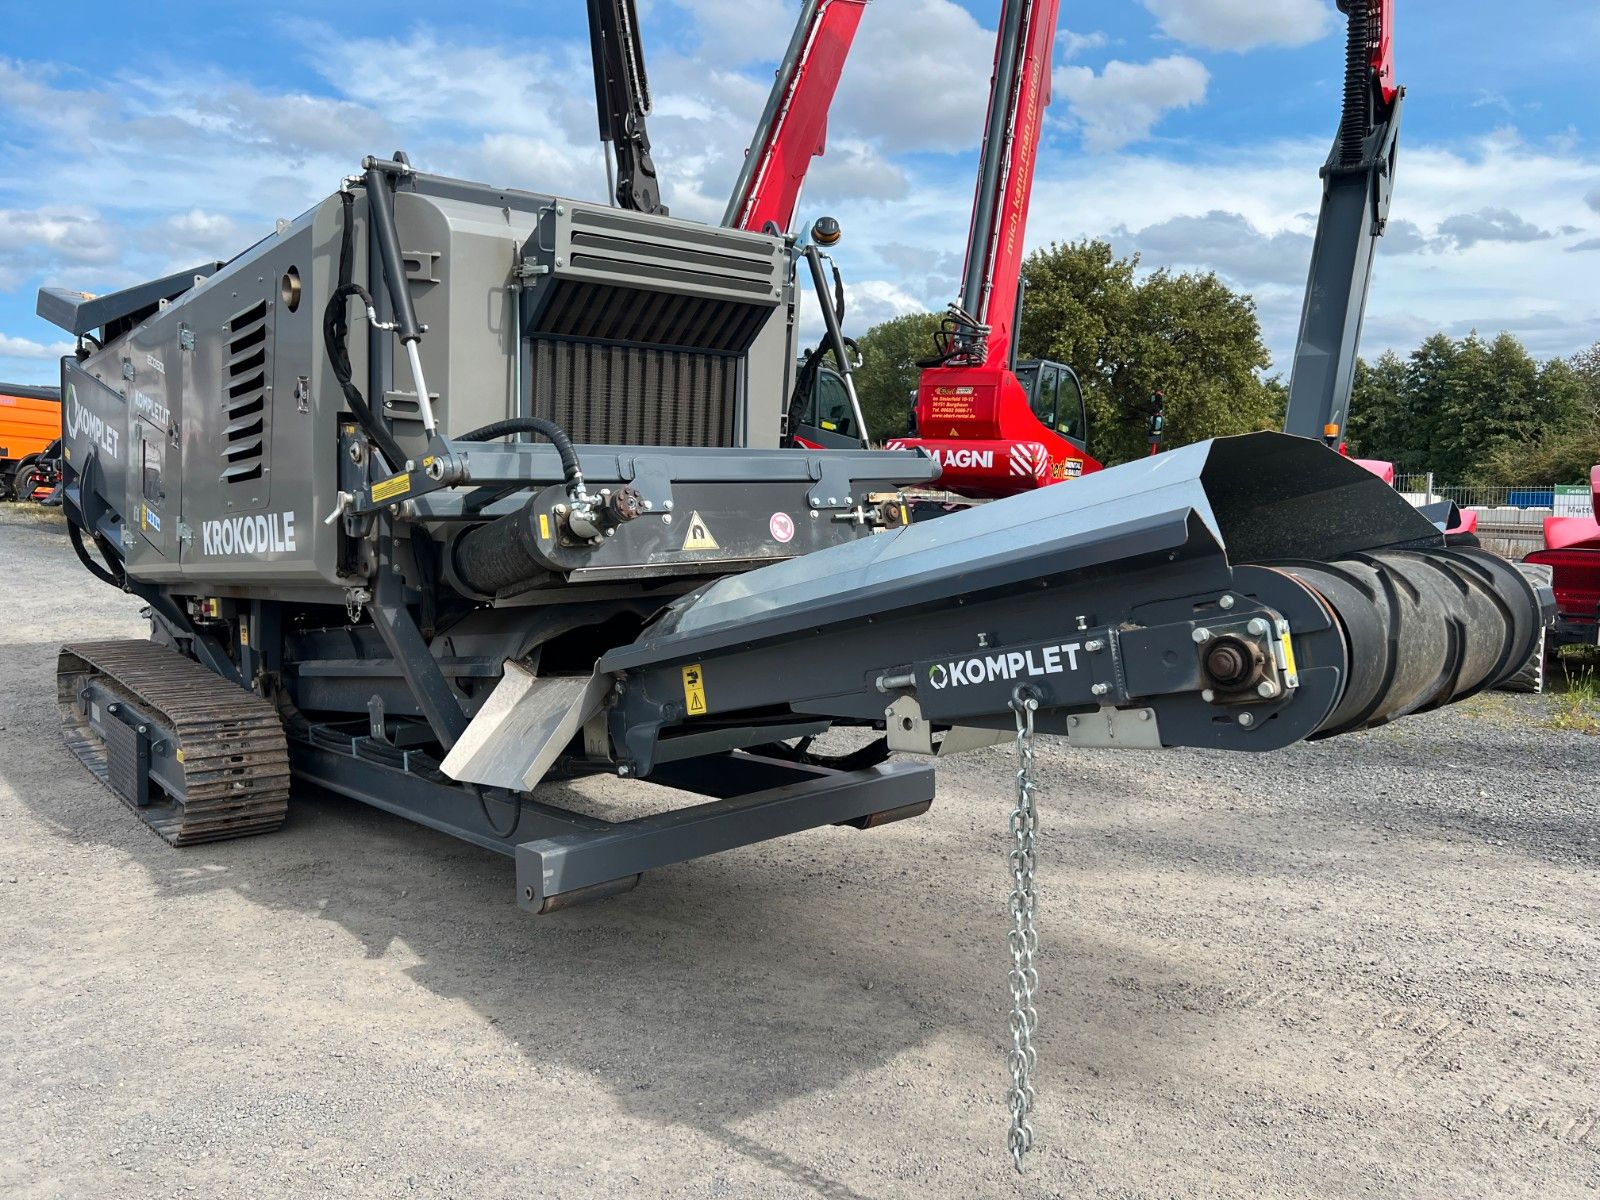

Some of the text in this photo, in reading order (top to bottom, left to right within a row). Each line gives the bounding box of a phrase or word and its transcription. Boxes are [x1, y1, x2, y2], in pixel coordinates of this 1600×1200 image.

[1006, 55, 1041, 256] mich kann man mieten!
[134, 388, 171, 427] KOMPLET.IT
[76, 403, 119, 459] KOMPLET
[202, 511, 296, 556] KROKODILE
[948, 643, 1081, 687] KOMPLET
